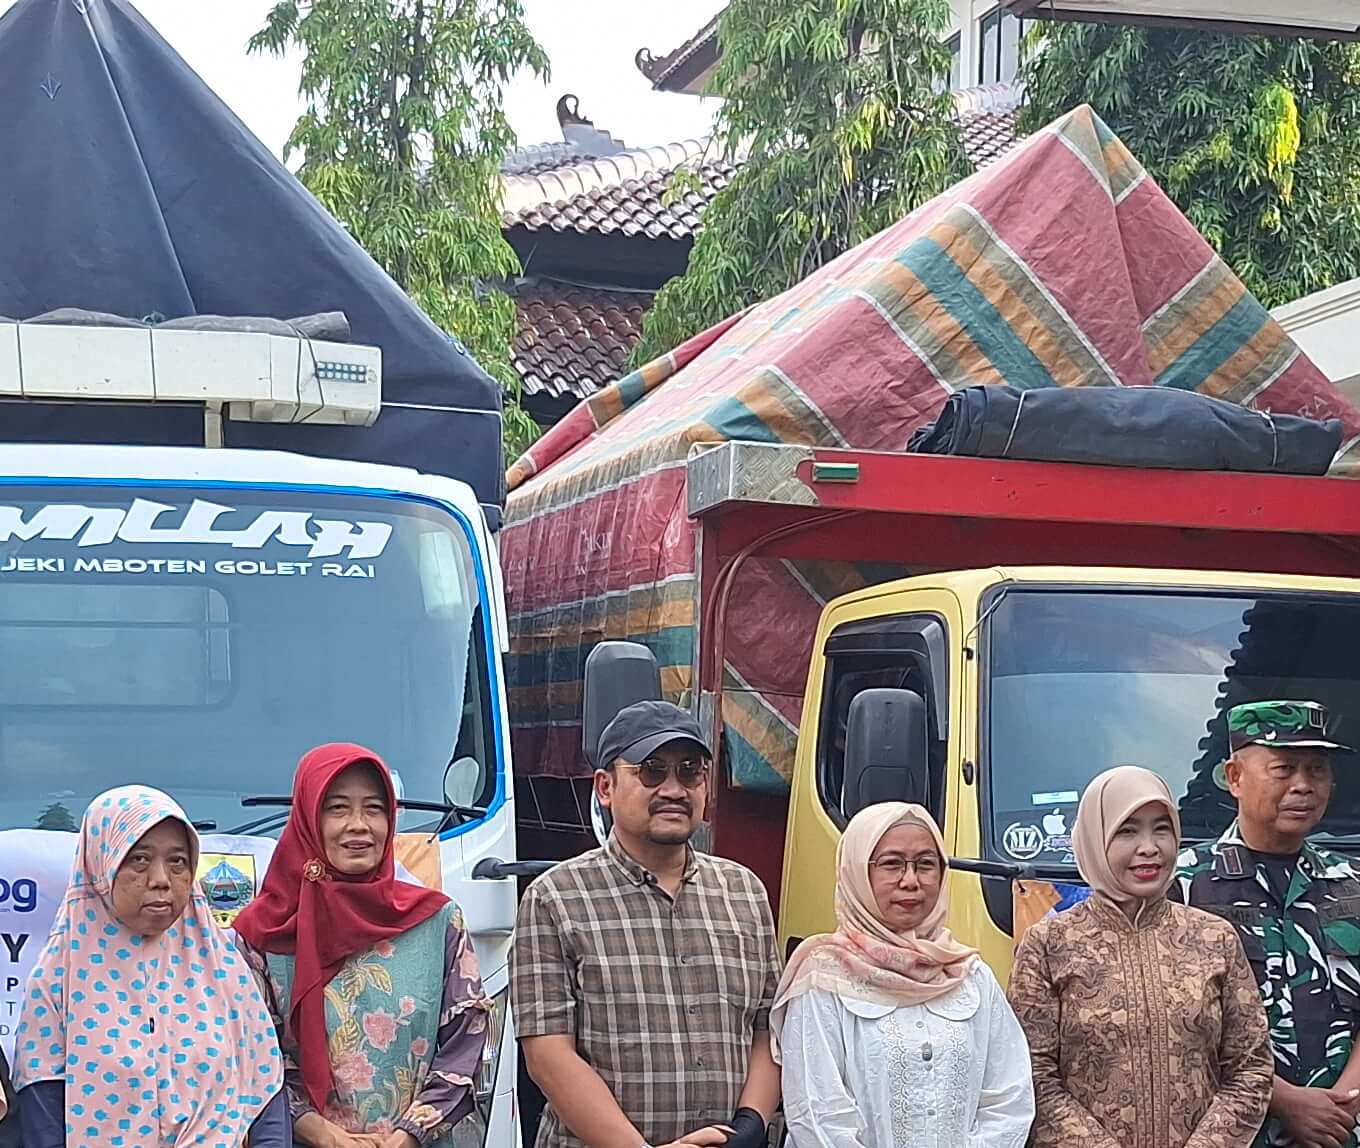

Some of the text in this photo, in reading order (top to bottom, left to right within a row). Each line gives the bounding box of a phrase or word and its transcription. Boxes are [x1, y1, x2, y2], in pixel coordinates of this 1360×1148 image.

[74, 558, 205, 574] MBOTEN
[215, 560, 312, 576] GOLET
[322, 563, 375, 578] RAI
